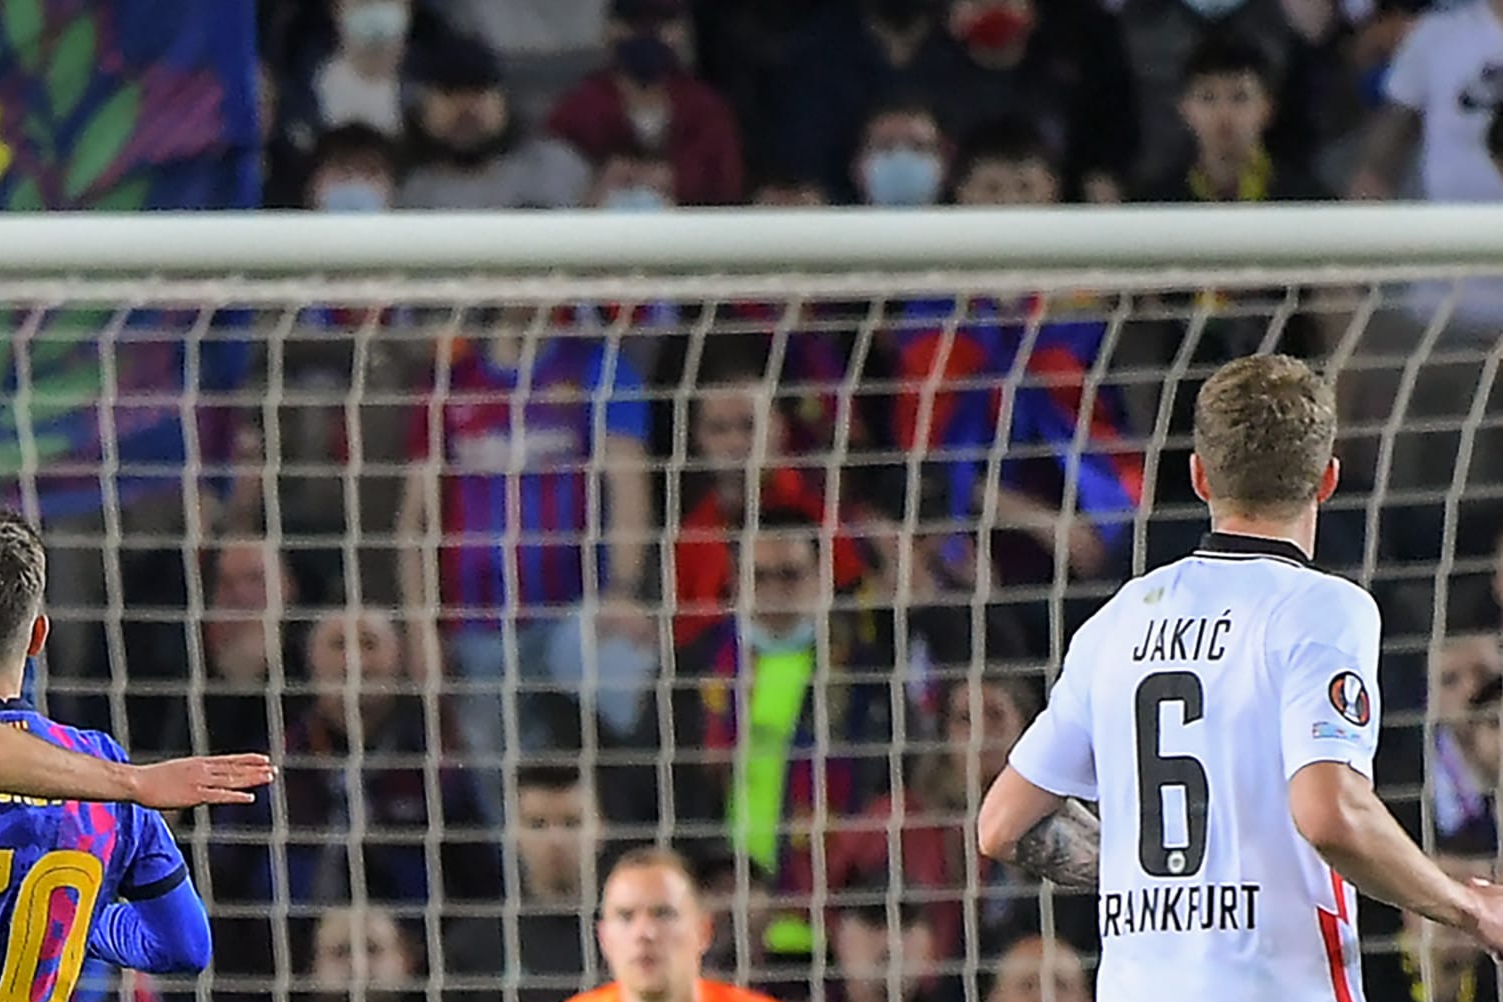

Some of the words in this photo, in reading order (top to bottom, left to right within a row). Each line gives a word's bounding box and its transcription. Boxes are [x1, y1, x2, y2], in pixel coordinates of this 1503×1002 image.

[1132, 609, 1232, 661] JAKIĆ
[1135, 671, 1210, 877] 6
[1098, 884, 1260, 938] RANKFURT
